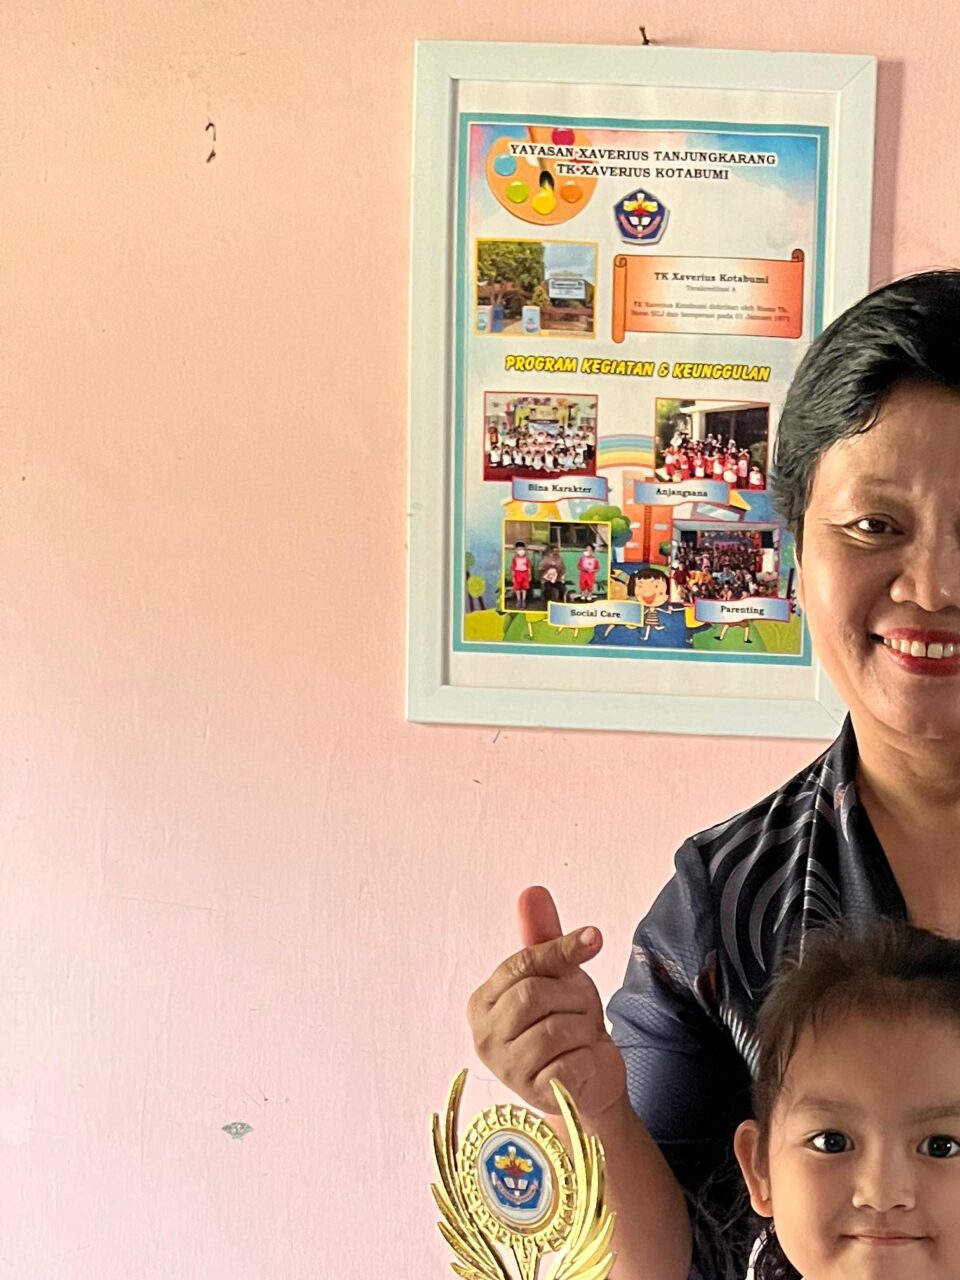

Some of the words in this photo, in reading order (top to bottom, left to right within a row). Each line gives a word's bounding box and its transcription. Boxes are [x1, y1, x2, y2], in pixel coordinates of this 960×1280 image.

[511, 144, 573, 158] YAYASAN
[579, 148, 649, 162] XAVERIUS
[654, 151, 776, 165] TANJUNGKARANG
[557, 163, 576, 176] TK
[580, 165, 650, 178] XAVERIUS
[656, 168, 729, 180] KOTABUMI
[655, 272, 669, 281] TK
[671, 273, 717, 282] Xaverius
[720, 274, 769, 284] Kotabumi
[505, 354, 578, 373] PROGRAM
[580, 357, 654, 377] KEGIATAN
[658, 361, 669, 377] &
[672, 362, 771, 382] KEUNGGULAN
[528, 483, 549, 492] Bina
[551, 484, 593, 494] Karakter
[655, 487, 709, 498] Anjangsana
[570, 609, 597, 618] Social
[600, 609, 621, 619] Care
[720, 605, 765, 617] Parenting
